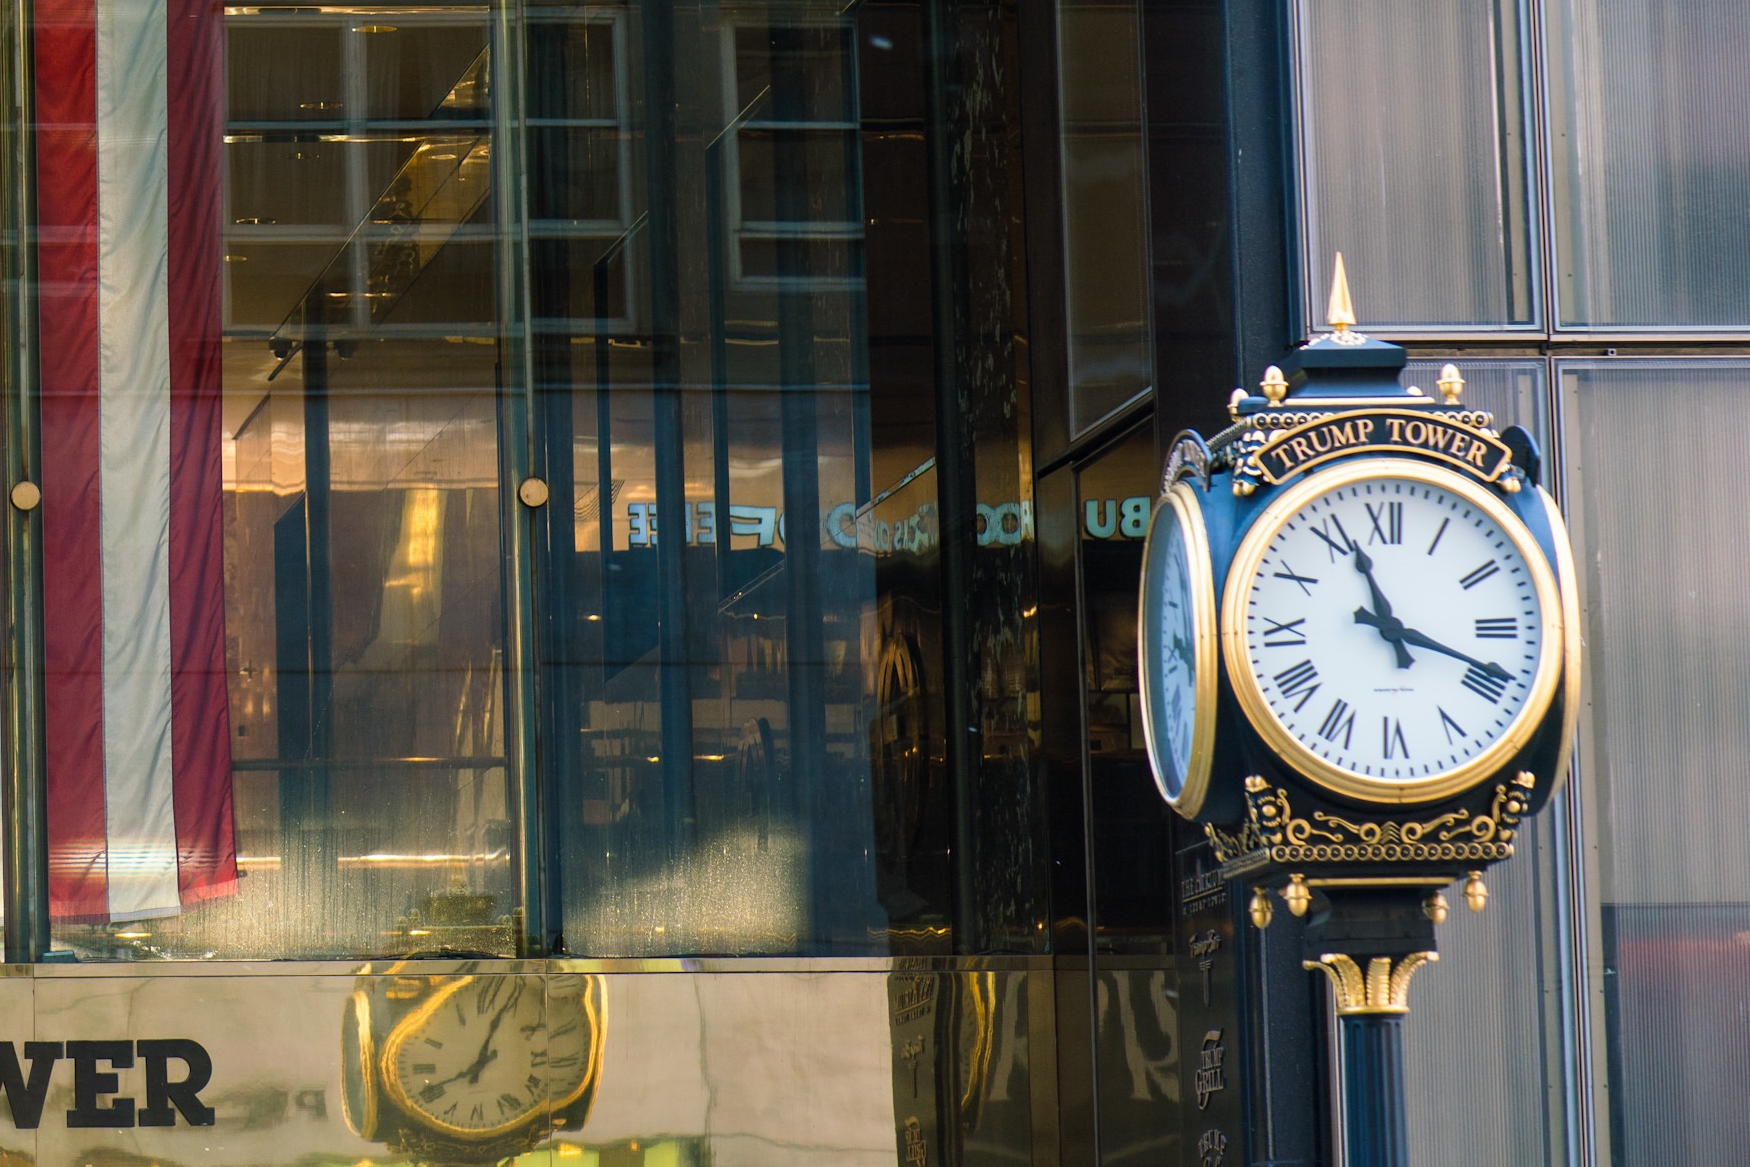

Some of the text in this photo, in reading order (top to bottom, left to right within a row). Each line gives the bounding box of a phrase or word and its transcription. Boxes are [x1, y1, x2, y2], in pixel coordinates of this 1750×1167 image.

[1270, 418, 1489, 469] TRUMP TOWER
[1365, 502, 1403, 546] XII
[1475, 618, 1518, 639] III
[1195, 1069, 1224, 1094] GRILL
